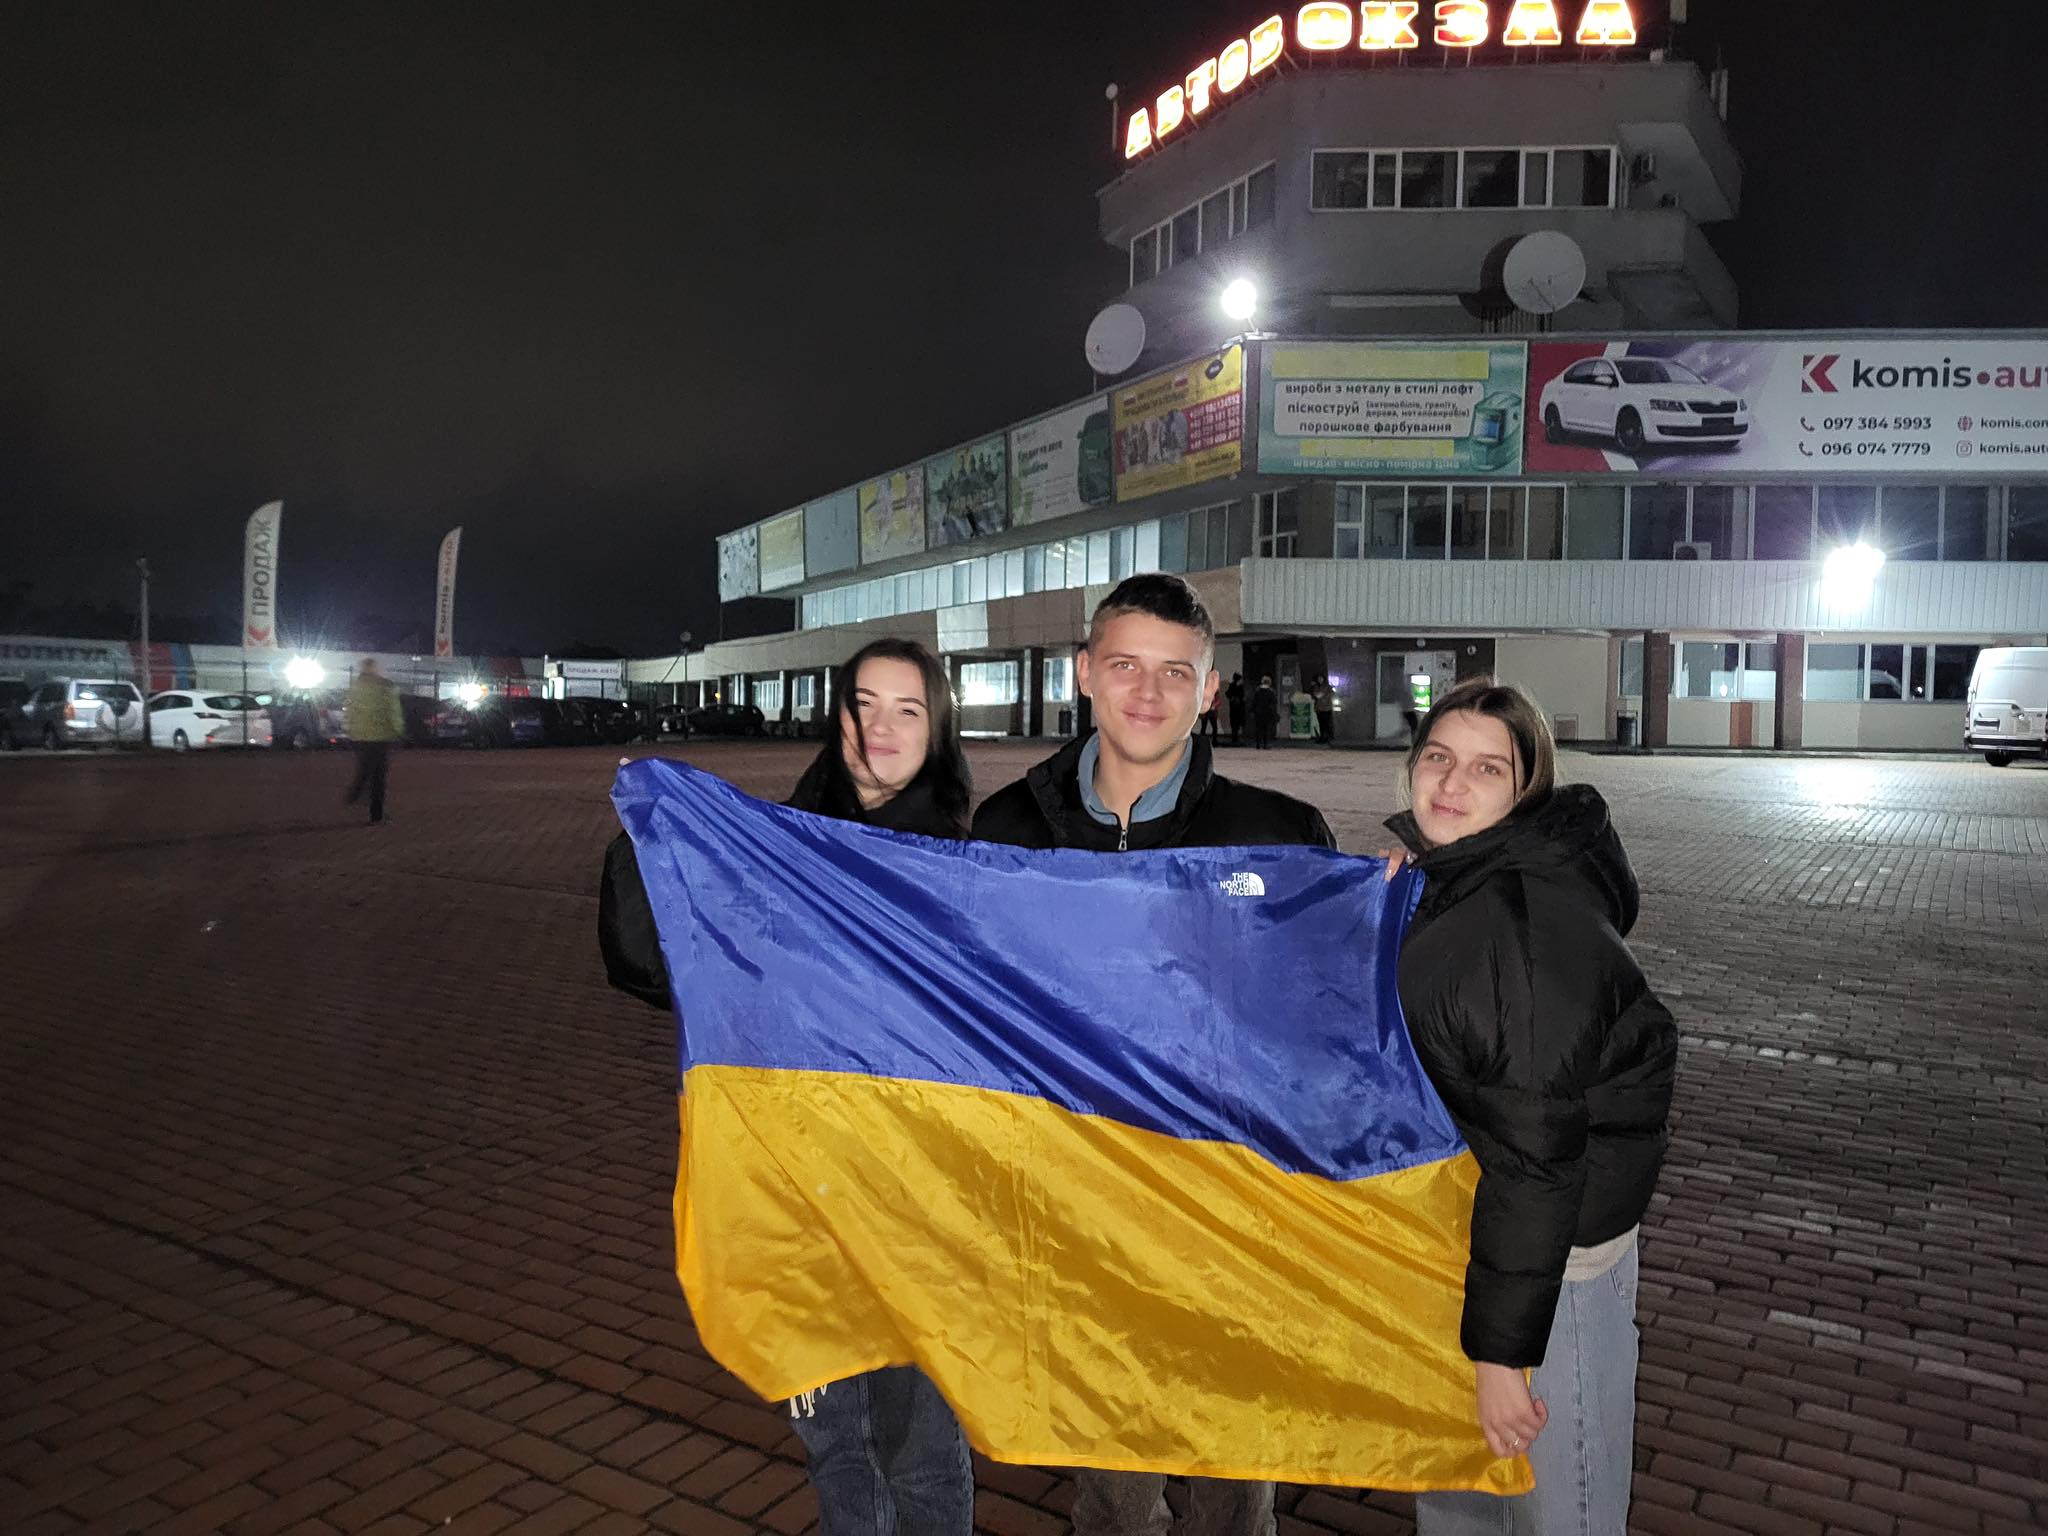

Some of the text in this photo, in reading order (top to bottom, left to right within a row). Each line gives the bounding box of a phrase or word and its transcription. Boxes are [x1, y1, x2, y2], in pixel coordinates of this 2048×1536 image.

[1285, 383, 1331, 396] вироби
[1346, 385, 1390, 396] металу
[1406, 383, 1438, 393] стилі
[1442, 384, 1474, 396] лофт
[1288, 401, 1360, 417] піскоструй
[1300, 421, 1452, 434] порошкове фарбування
[1823, 417, 1932, 430] 097 384 5993
[1822, 442, 1931, 456] 096 074 7779
[1980, 442, 2048, 454] komis.aut
[252, 519, 272, 616] ПРОДАЖ
[1232, 872, 1249, 881] THE
[1219, 880, 1249, 889] NORTH
[1228, 888, 1249, 896] FACE
